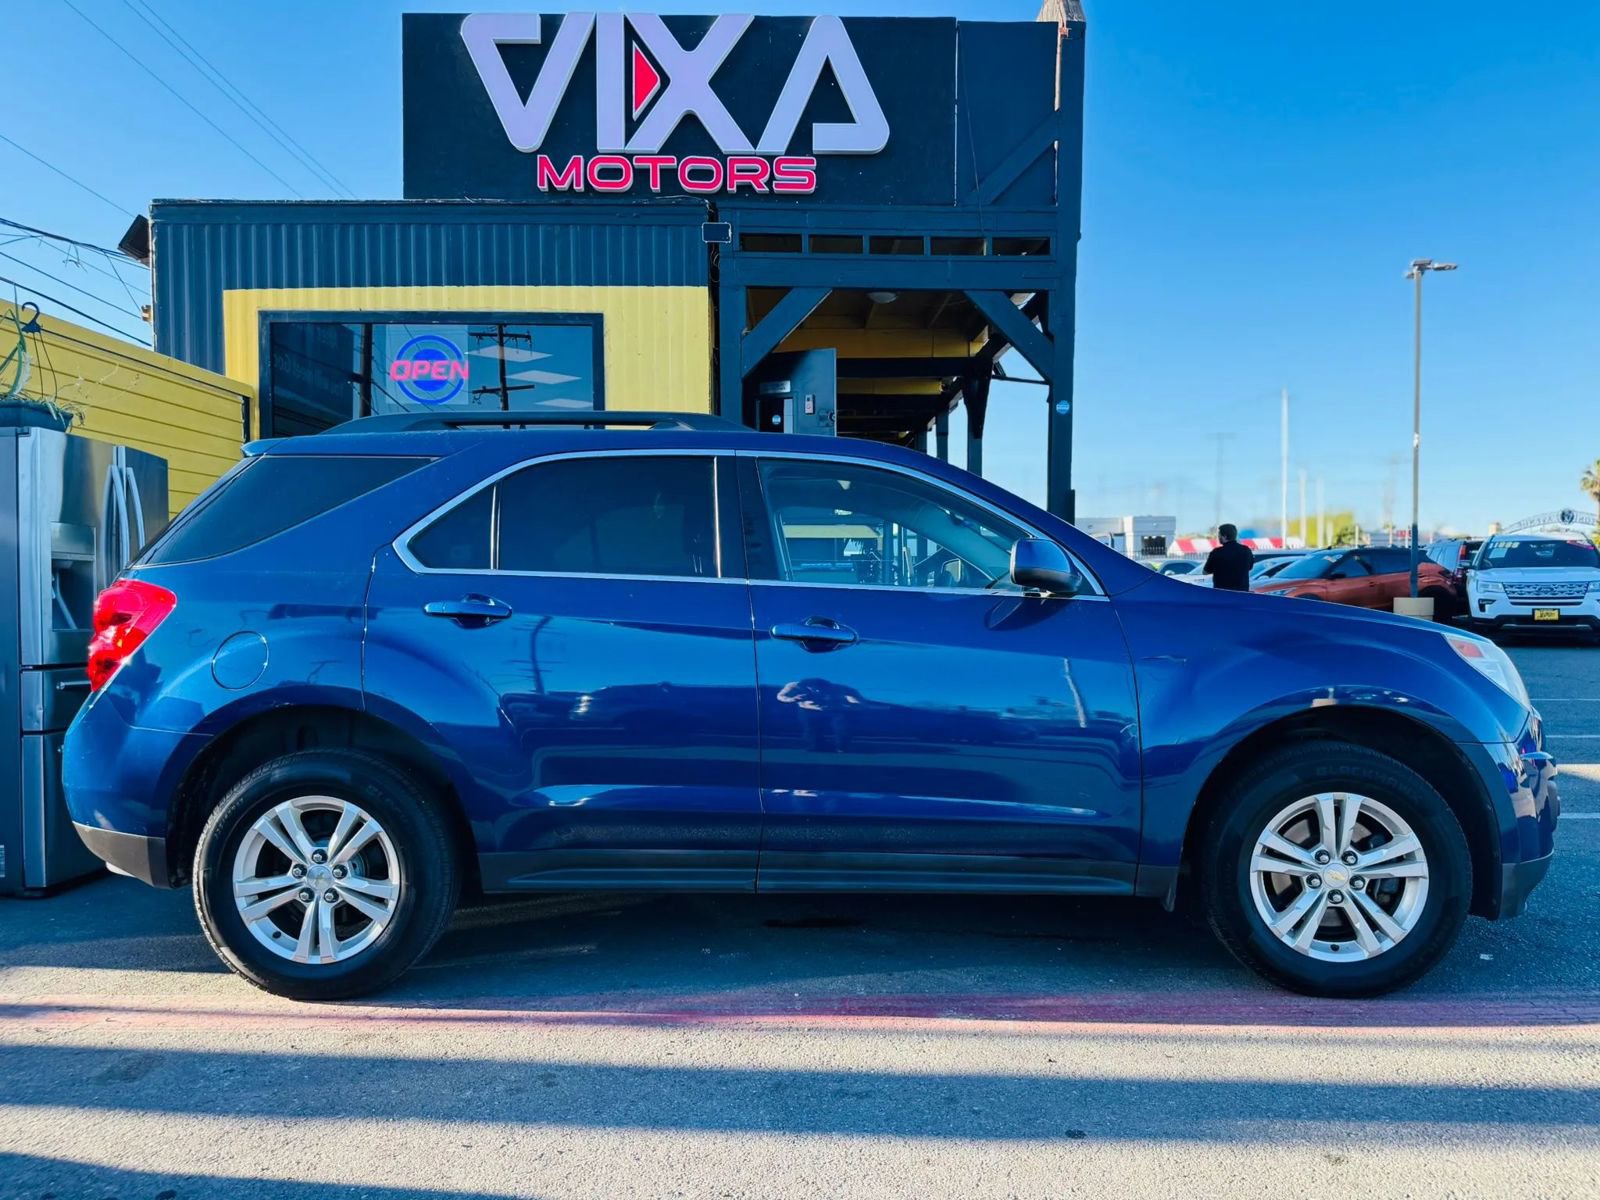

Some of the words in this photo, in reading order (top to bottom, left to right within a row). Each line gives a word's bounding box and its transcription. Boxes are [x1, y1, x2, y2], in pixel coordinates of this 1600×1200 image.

[460, 12, 890, 155] VIXA
[537, 155, 816, 193] MOTORS
[389, 360, 470, 381] OPEN
